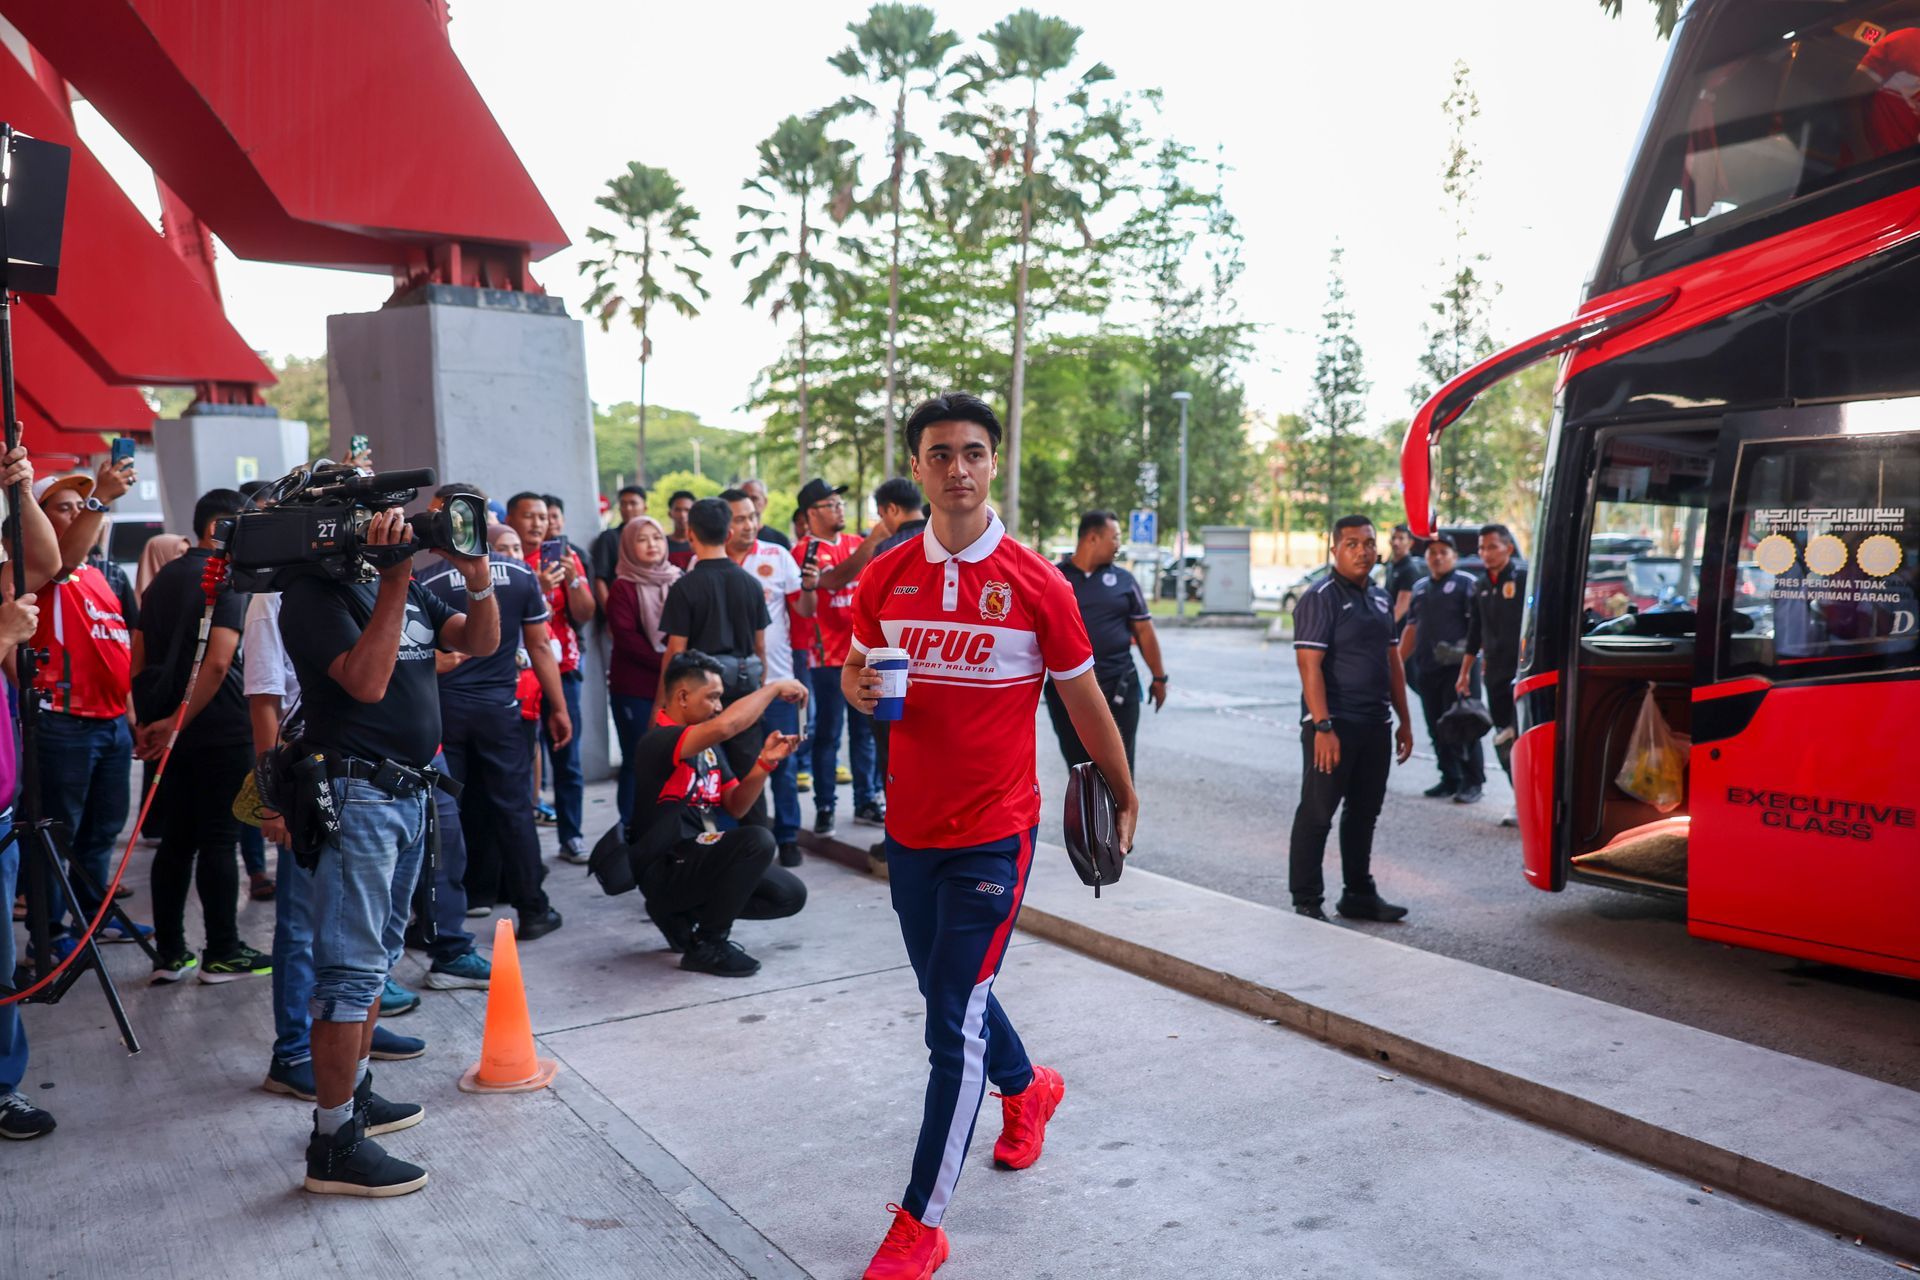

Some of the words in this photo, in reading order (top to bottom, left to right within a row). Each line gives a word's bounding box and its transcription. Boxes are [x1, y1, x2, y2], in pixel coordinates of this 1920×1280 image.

[318, 523, 337, 537] 27
[1802, 578, 1852, 589] PERDANA
[1854, 579, 1887, 590] TIDAK
[1807, 590, 1851, 601] KIRIMAN
[1853, 592, 1901, 603] BARANG
[912, 661, 943, 669] SPORT
[945, 664, 995, 673] MALAYSIA
[1726, 786, 1917, 828] EXECUTIVE
[1761, 810, 1873, 841] CLASS
